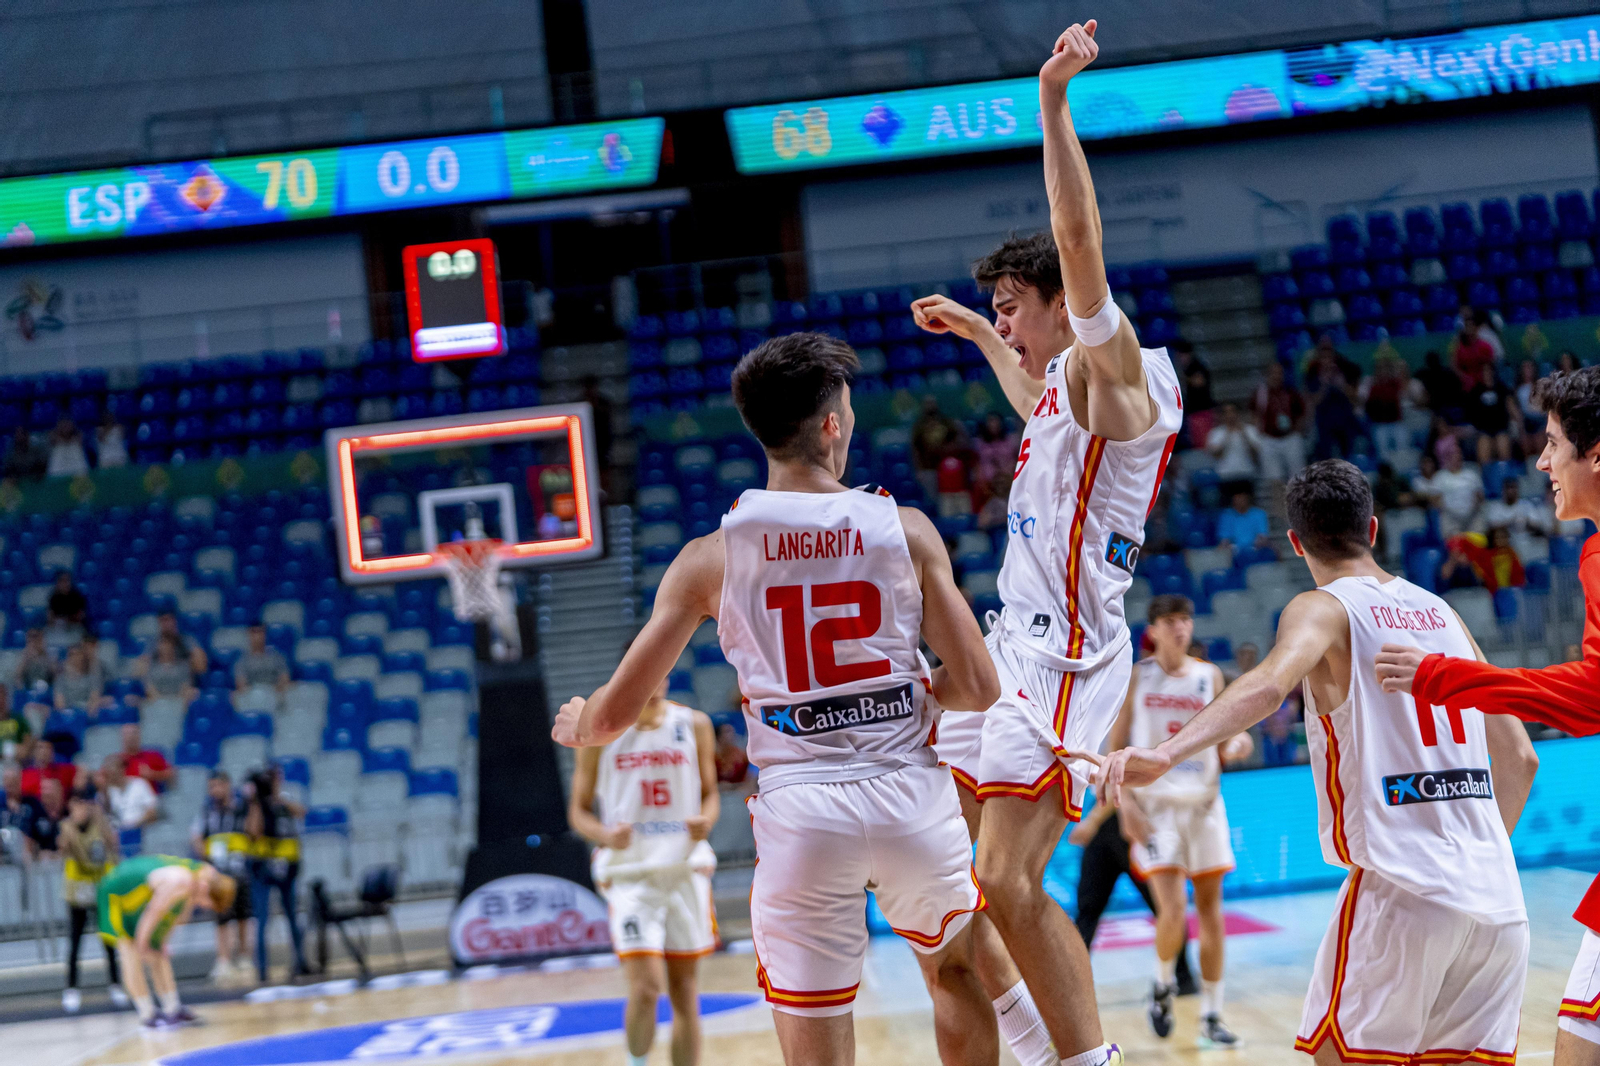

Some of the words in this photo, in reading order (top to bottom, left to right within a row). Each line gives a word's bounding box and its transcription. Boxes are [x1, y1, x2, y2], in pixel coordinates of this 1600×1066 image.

[772, 106, 832, 160] 68
[926, 97, 1018, 141] AUS
[67, 181, 151, 229] ESP
[256, 158, 318, 210] 70
[377, 145, 461, 198] 0.0
[763, 528, 865, 562] LANGARITA
[765, 580, 892, 693] 12
[1039, 616, 1044, 624] L
[794, 690, 914, 732] CaixaBank
[1418, 772, 1491, 799] CaixaBank
